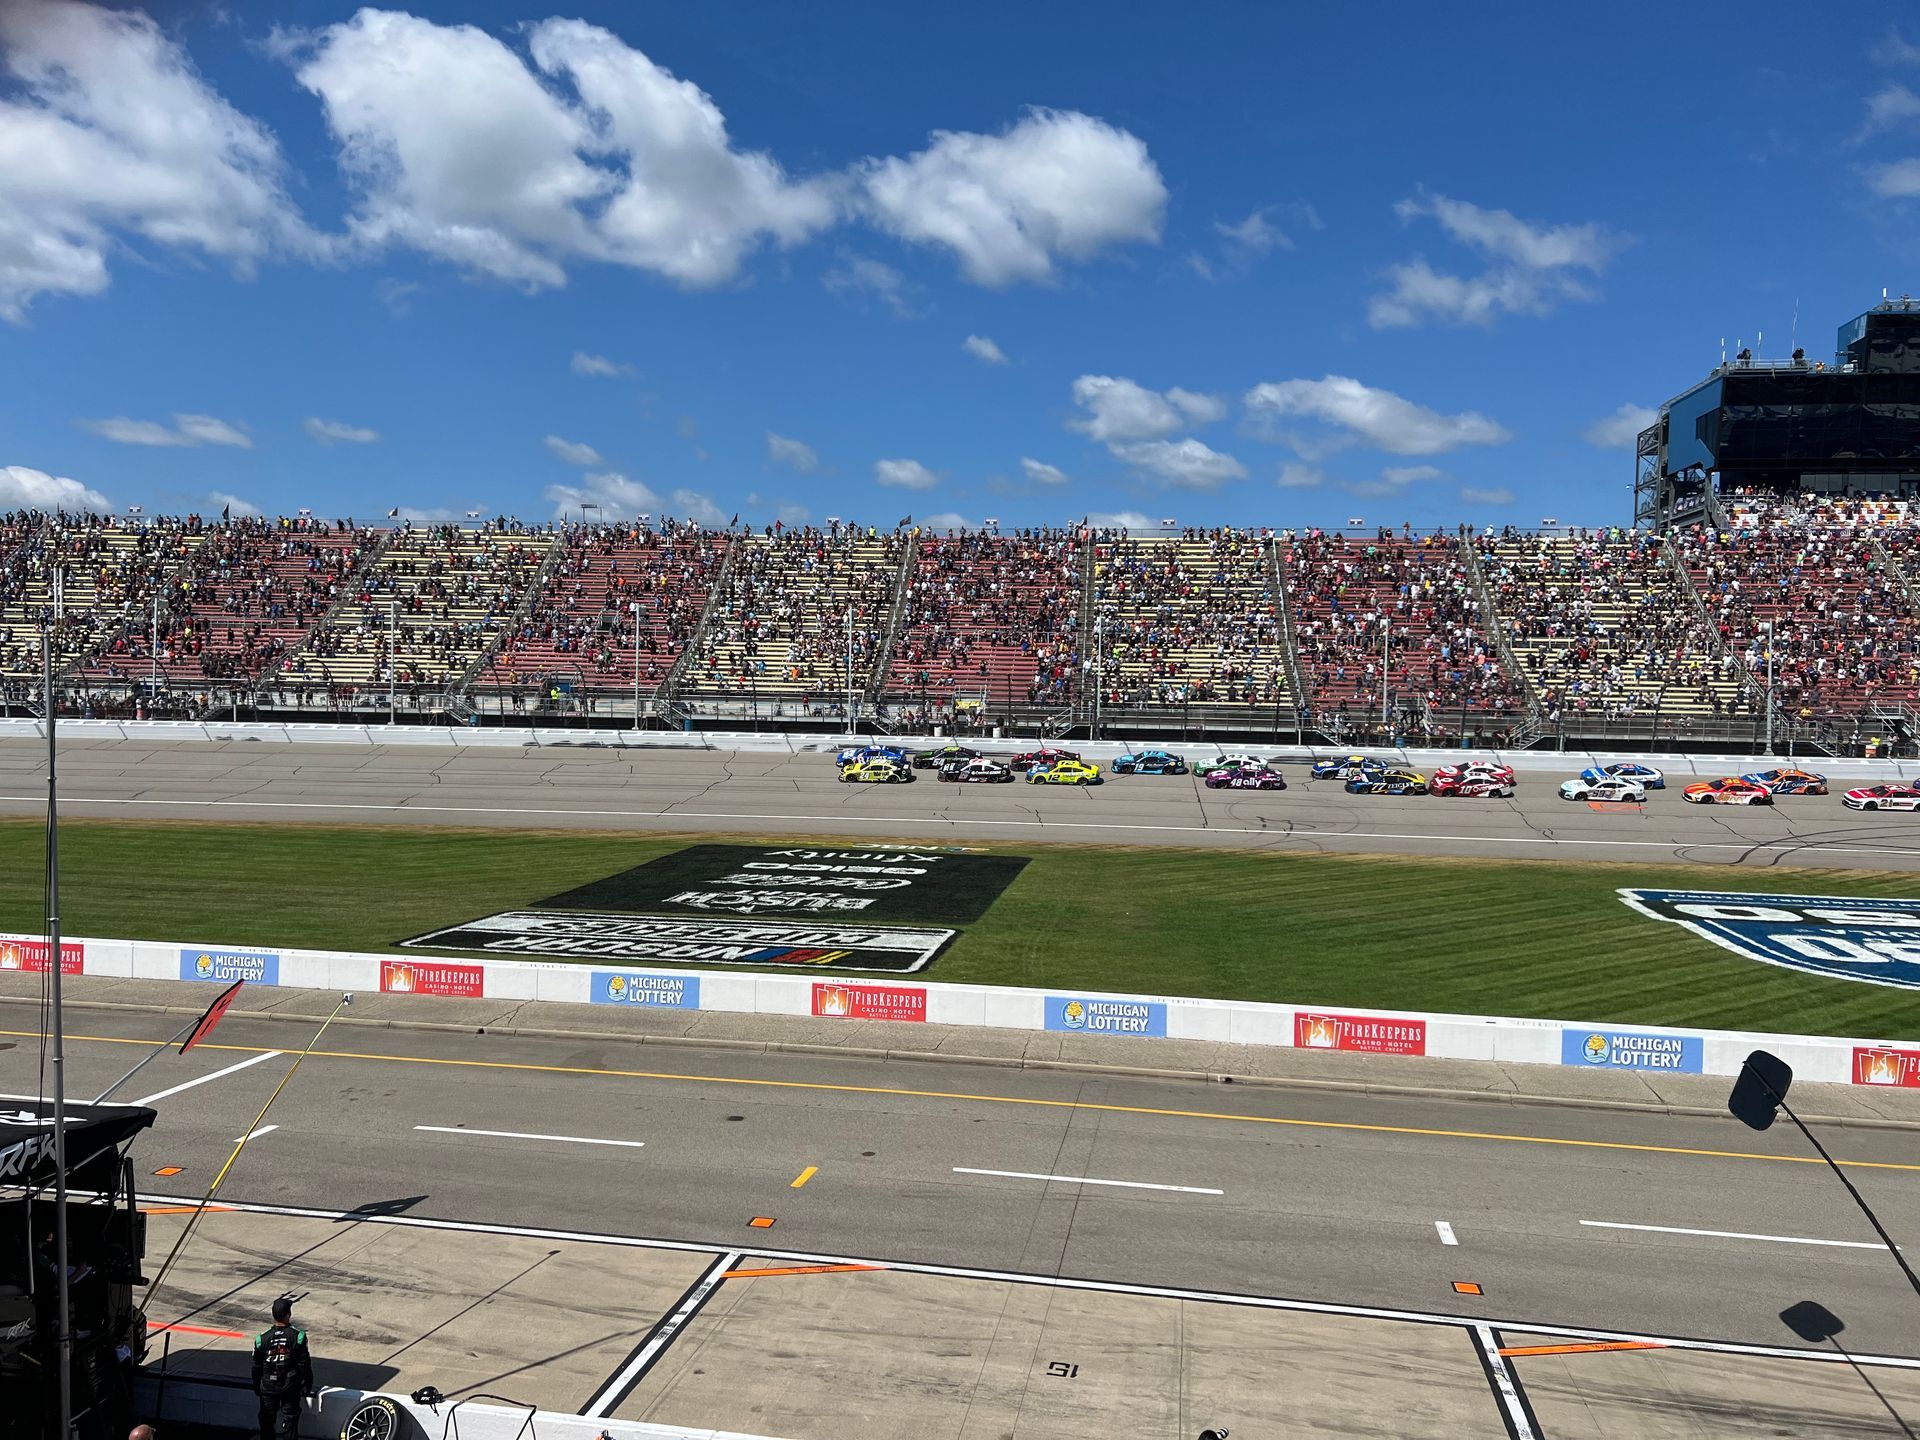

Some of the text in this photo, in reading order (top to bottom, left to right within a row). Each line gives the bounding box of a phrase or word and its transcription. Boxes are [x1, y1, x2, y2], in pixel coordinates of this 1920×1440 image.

[1134, 763, 1145, 771] 19
[1230, 777, 1262, 788] 48 ally
[1372, 782, 1388, 791] 77
[1459, 785, 1472, 794] 10
[743, 862, 927, 875] GEICO
[662, 891, 878, 910] BUSCH
[483, 936, 759, 960] NASCAR
[215, 955, 264, 968] MICHIGAN
[215, 966, 264, 981] LOTTERY
[630, 976, 683, 990] MICHIGAN
[630, 989, 683, 1004] LOTTERY
[1088, 1003, 1148, 1017] MICHIGAN
[1088, 1016, 1149, 1031] LOTTERY
[1612, 1036, 1682, 1052] MICHIGAN
[1612, 1050, 1682, 1067] LOTTERY
